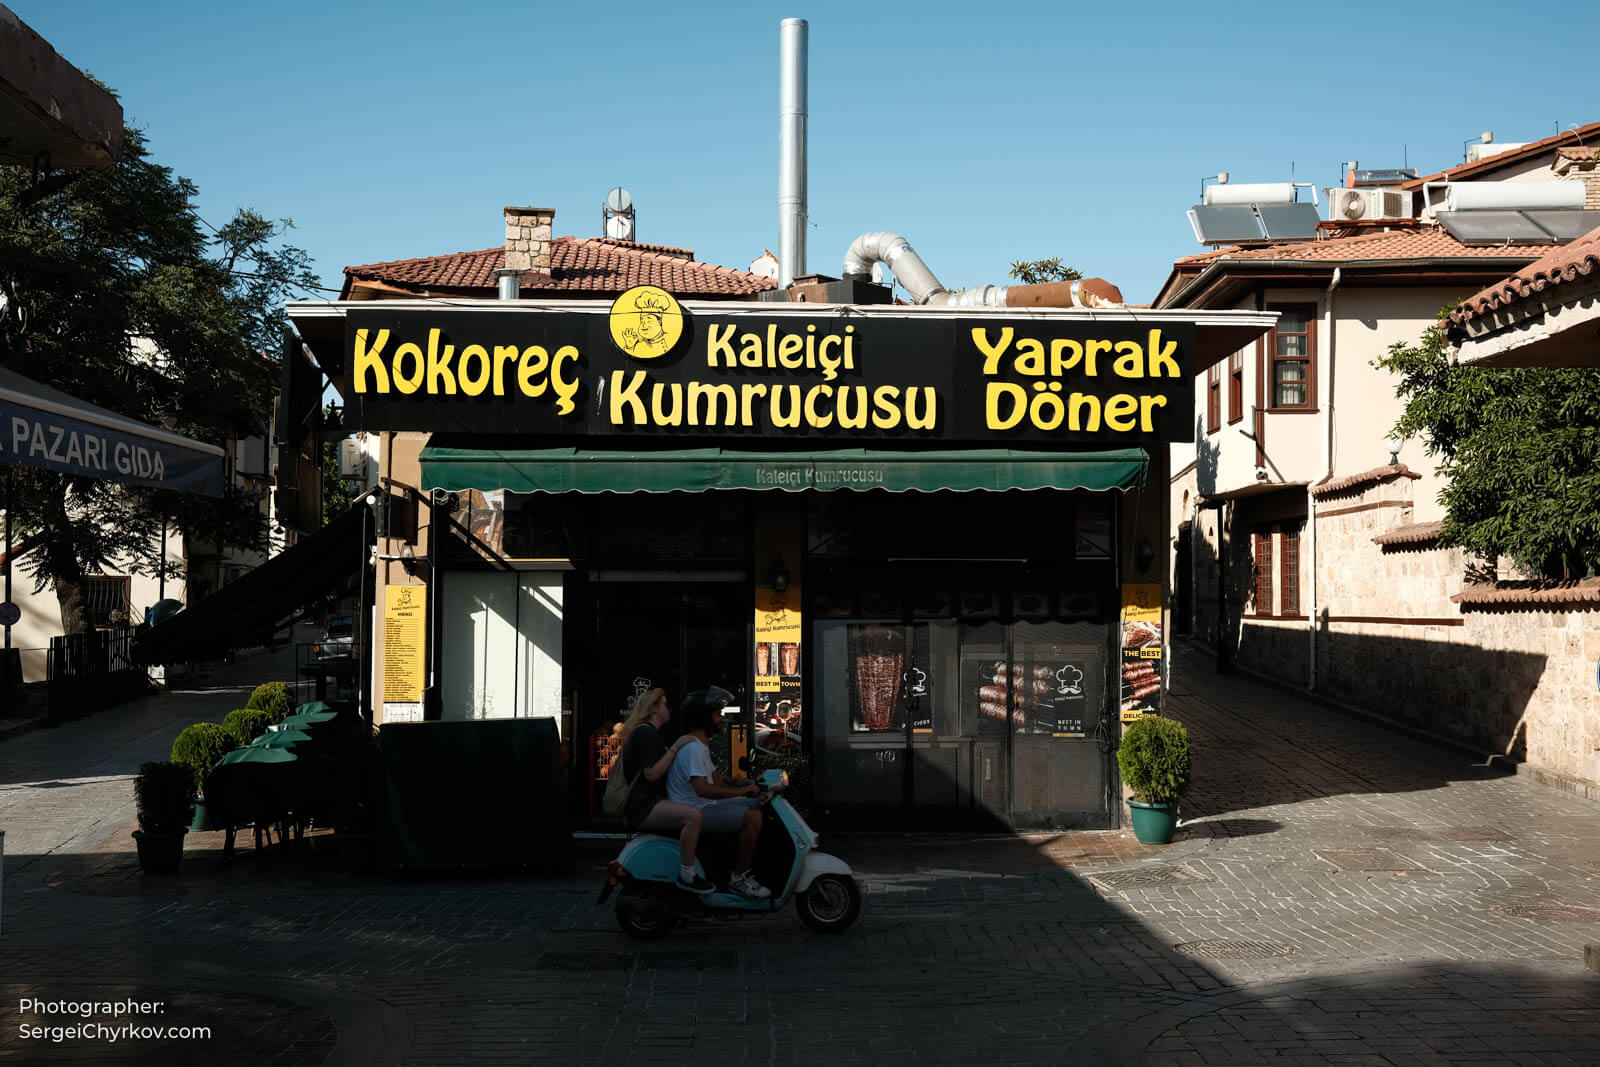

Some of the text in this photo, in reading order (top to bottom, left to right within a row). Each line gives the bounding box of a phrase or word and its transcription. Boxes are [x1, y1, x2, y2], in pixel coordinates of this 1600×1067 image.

[354, 328, 579, 416] Kokoreç
[708, 324, 854, 381] Kaleiçi
[972, 328, 1181, 378] Yaprak
[610, 370, 937, 430] Kumrucusu
[986, 381, 1167, 433] Döner
[12, 416, 107, 471] PAZARI
[114, 441, 165, 481] GIDA
[756, 467, 884, 487] Kaleiçi Kumrucusu
